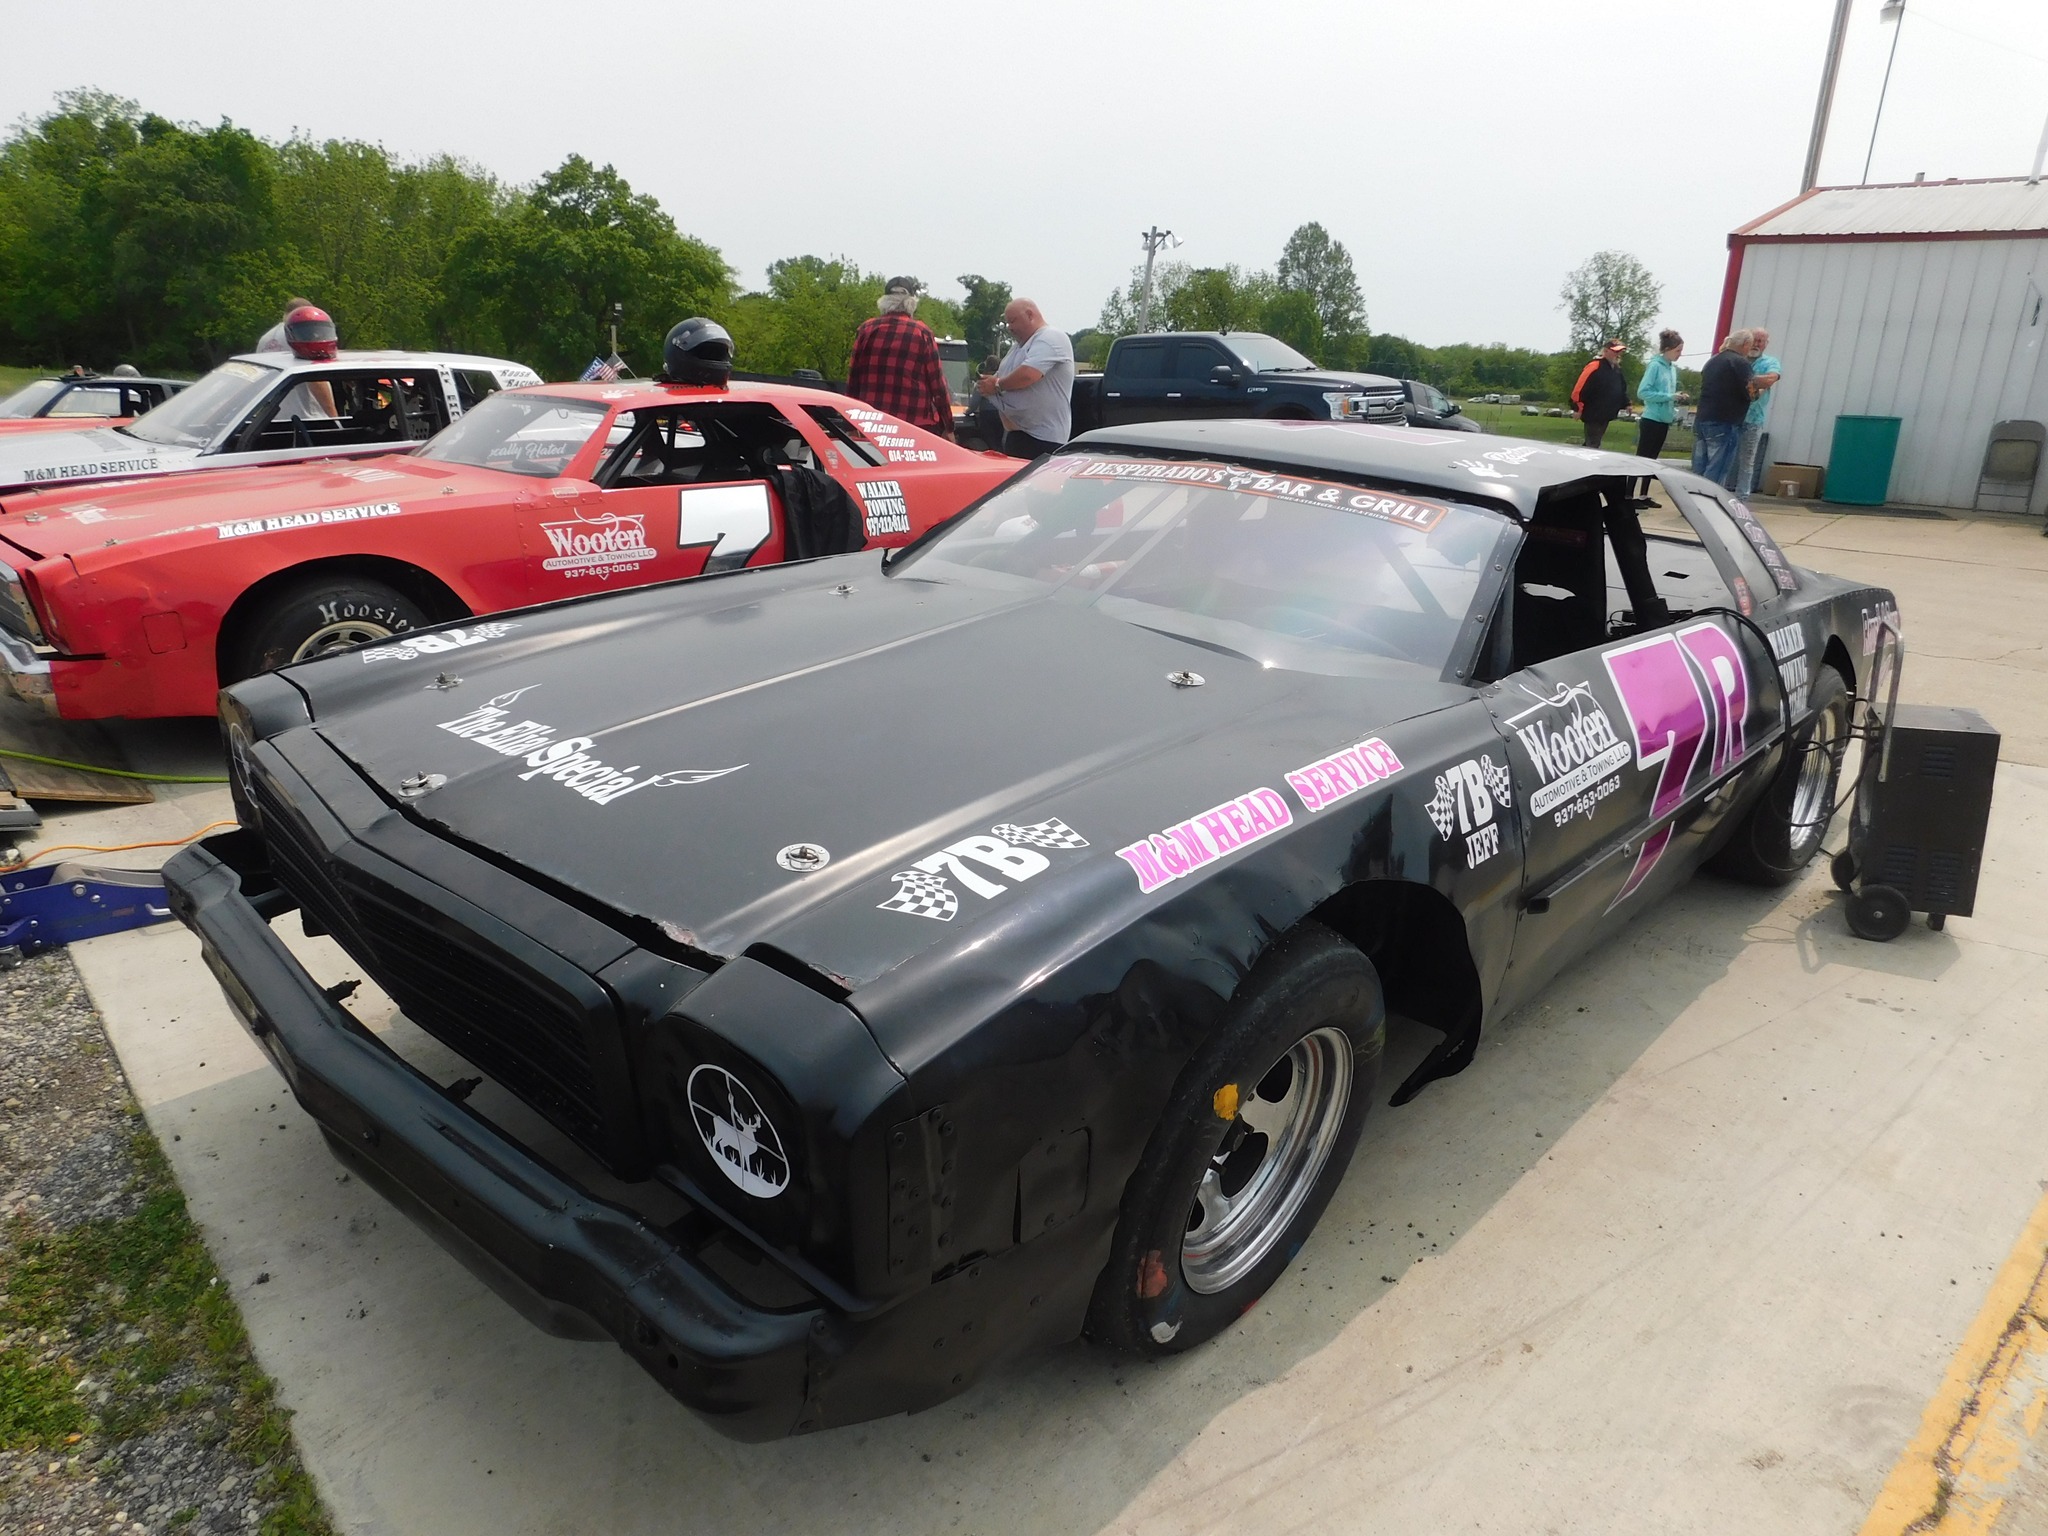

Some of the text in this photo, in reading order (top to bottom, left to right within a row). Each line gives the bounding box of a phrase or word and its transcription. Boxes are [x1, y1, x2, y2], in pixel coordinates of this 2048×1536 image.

[858, 421, 899, 434] RACING
[874, 435, 916, 447] DESIGNS
[24, 458, 159, 482] M&M HEAD SERVICE
[525, 442, 567, 458] Hated
[856, 480, 903, 499] WALKER
[864, 498, 906, 516] TOWING
[1081, 462, 1429, 525] DESPERADO'S BAR & GRILL
[217, 521, 264, 539] M&M
[266, 512, 320, 531] HEAD
[321, 502, 401, 523] SERVICE
[543, 523, 648, 557] Wooten
[677, 484, 773, 576] 7
[545, 548, 655, 569] AUTOMOTIVE & TOWING LLC
[564, 562, 640, 578] 937-663-0063
[436, 706, 511, 738] The
[517, 736, 664, 806] Special
[1515, 706, 1619, 784] Wooten
[1445, 759, 1493, 835] 7B
[1533, 743, 1630, 812] AUTOMOTIVE & TOWING LLC
[1120, 739, 1402, 893] M&M HEAD SERVICE
[1553, 774, 1621, 828] 937-663-0063
[920, 834, 1051, 900] 7B
[1465, 822, 1499, 870] JEFF
